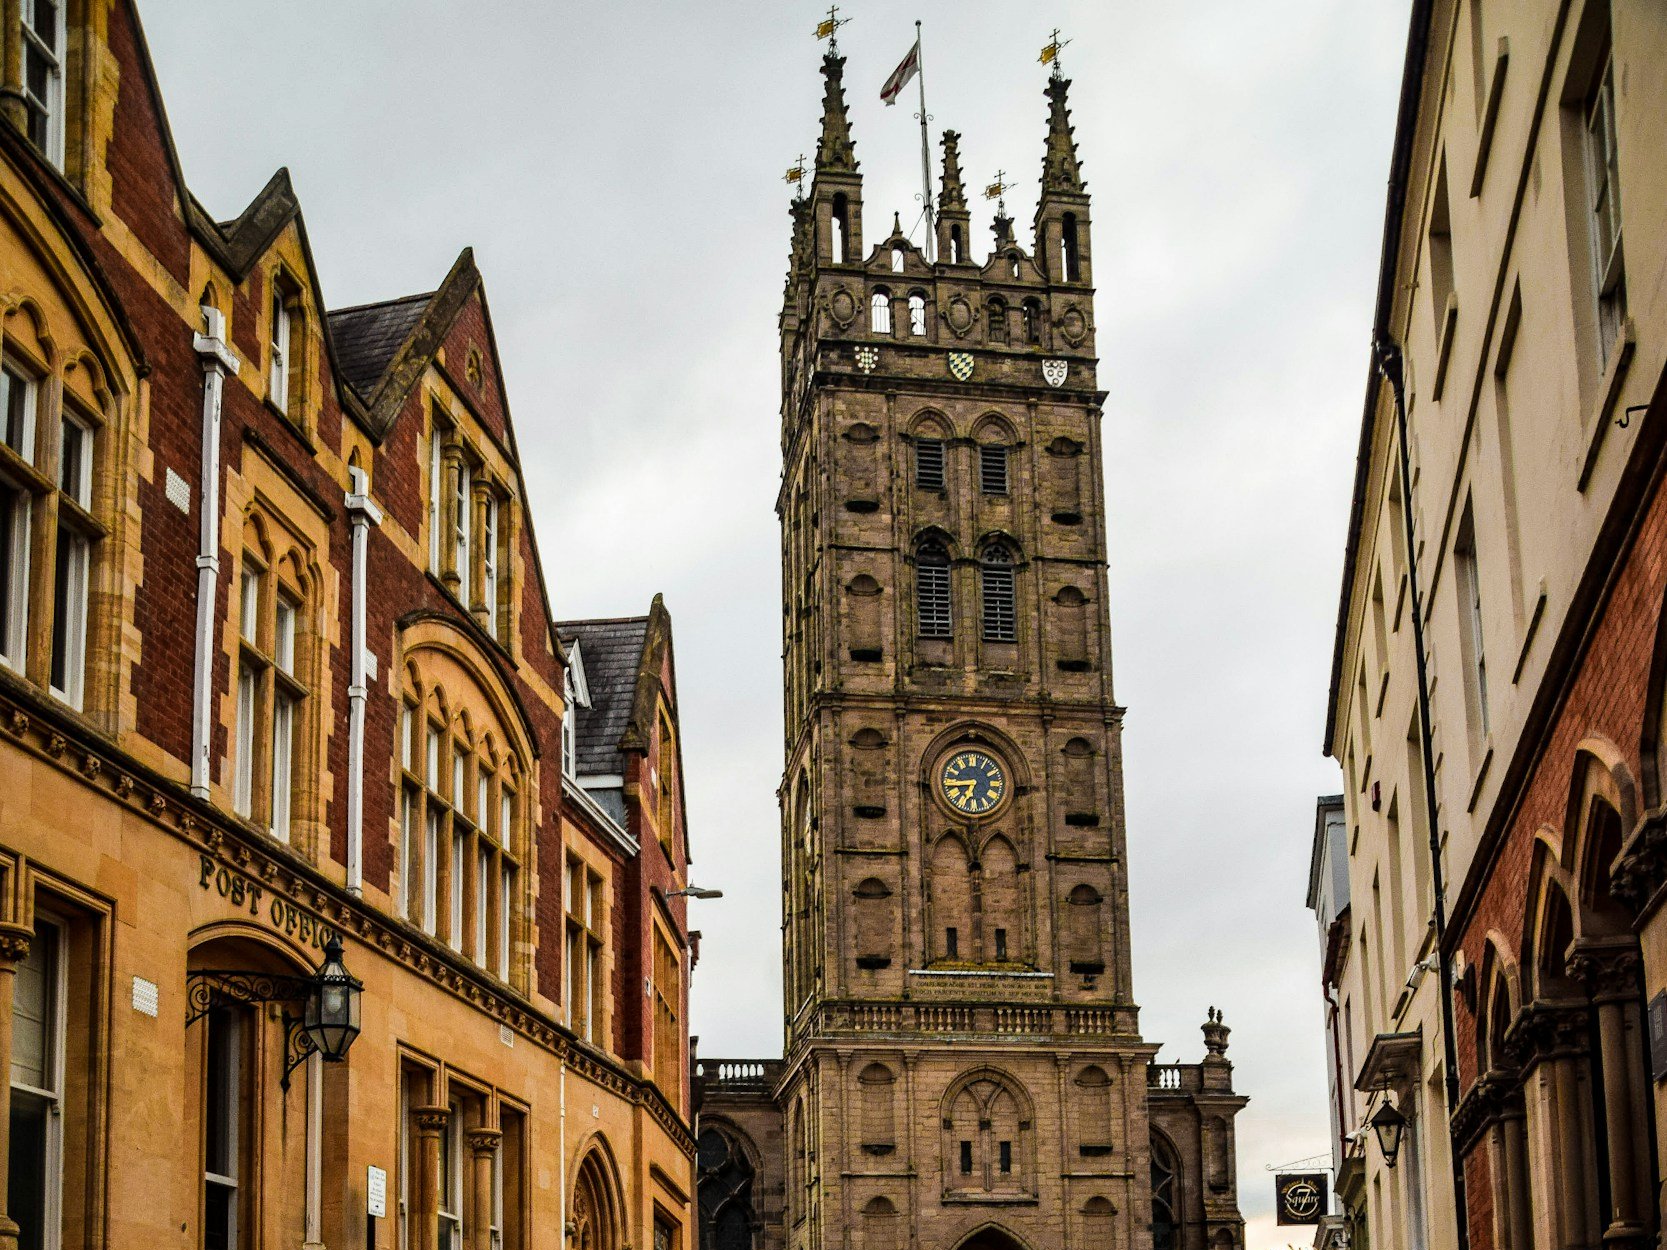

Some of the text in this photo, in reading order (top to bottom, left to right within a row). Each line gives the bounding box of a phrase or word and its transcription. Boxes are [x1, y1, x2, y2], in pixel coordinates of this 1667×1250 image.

[199, 854, 263, 915] POST
[1284, 1193, 1320, 1207] Square
[1297, 1188, 1311, 1211] 7
